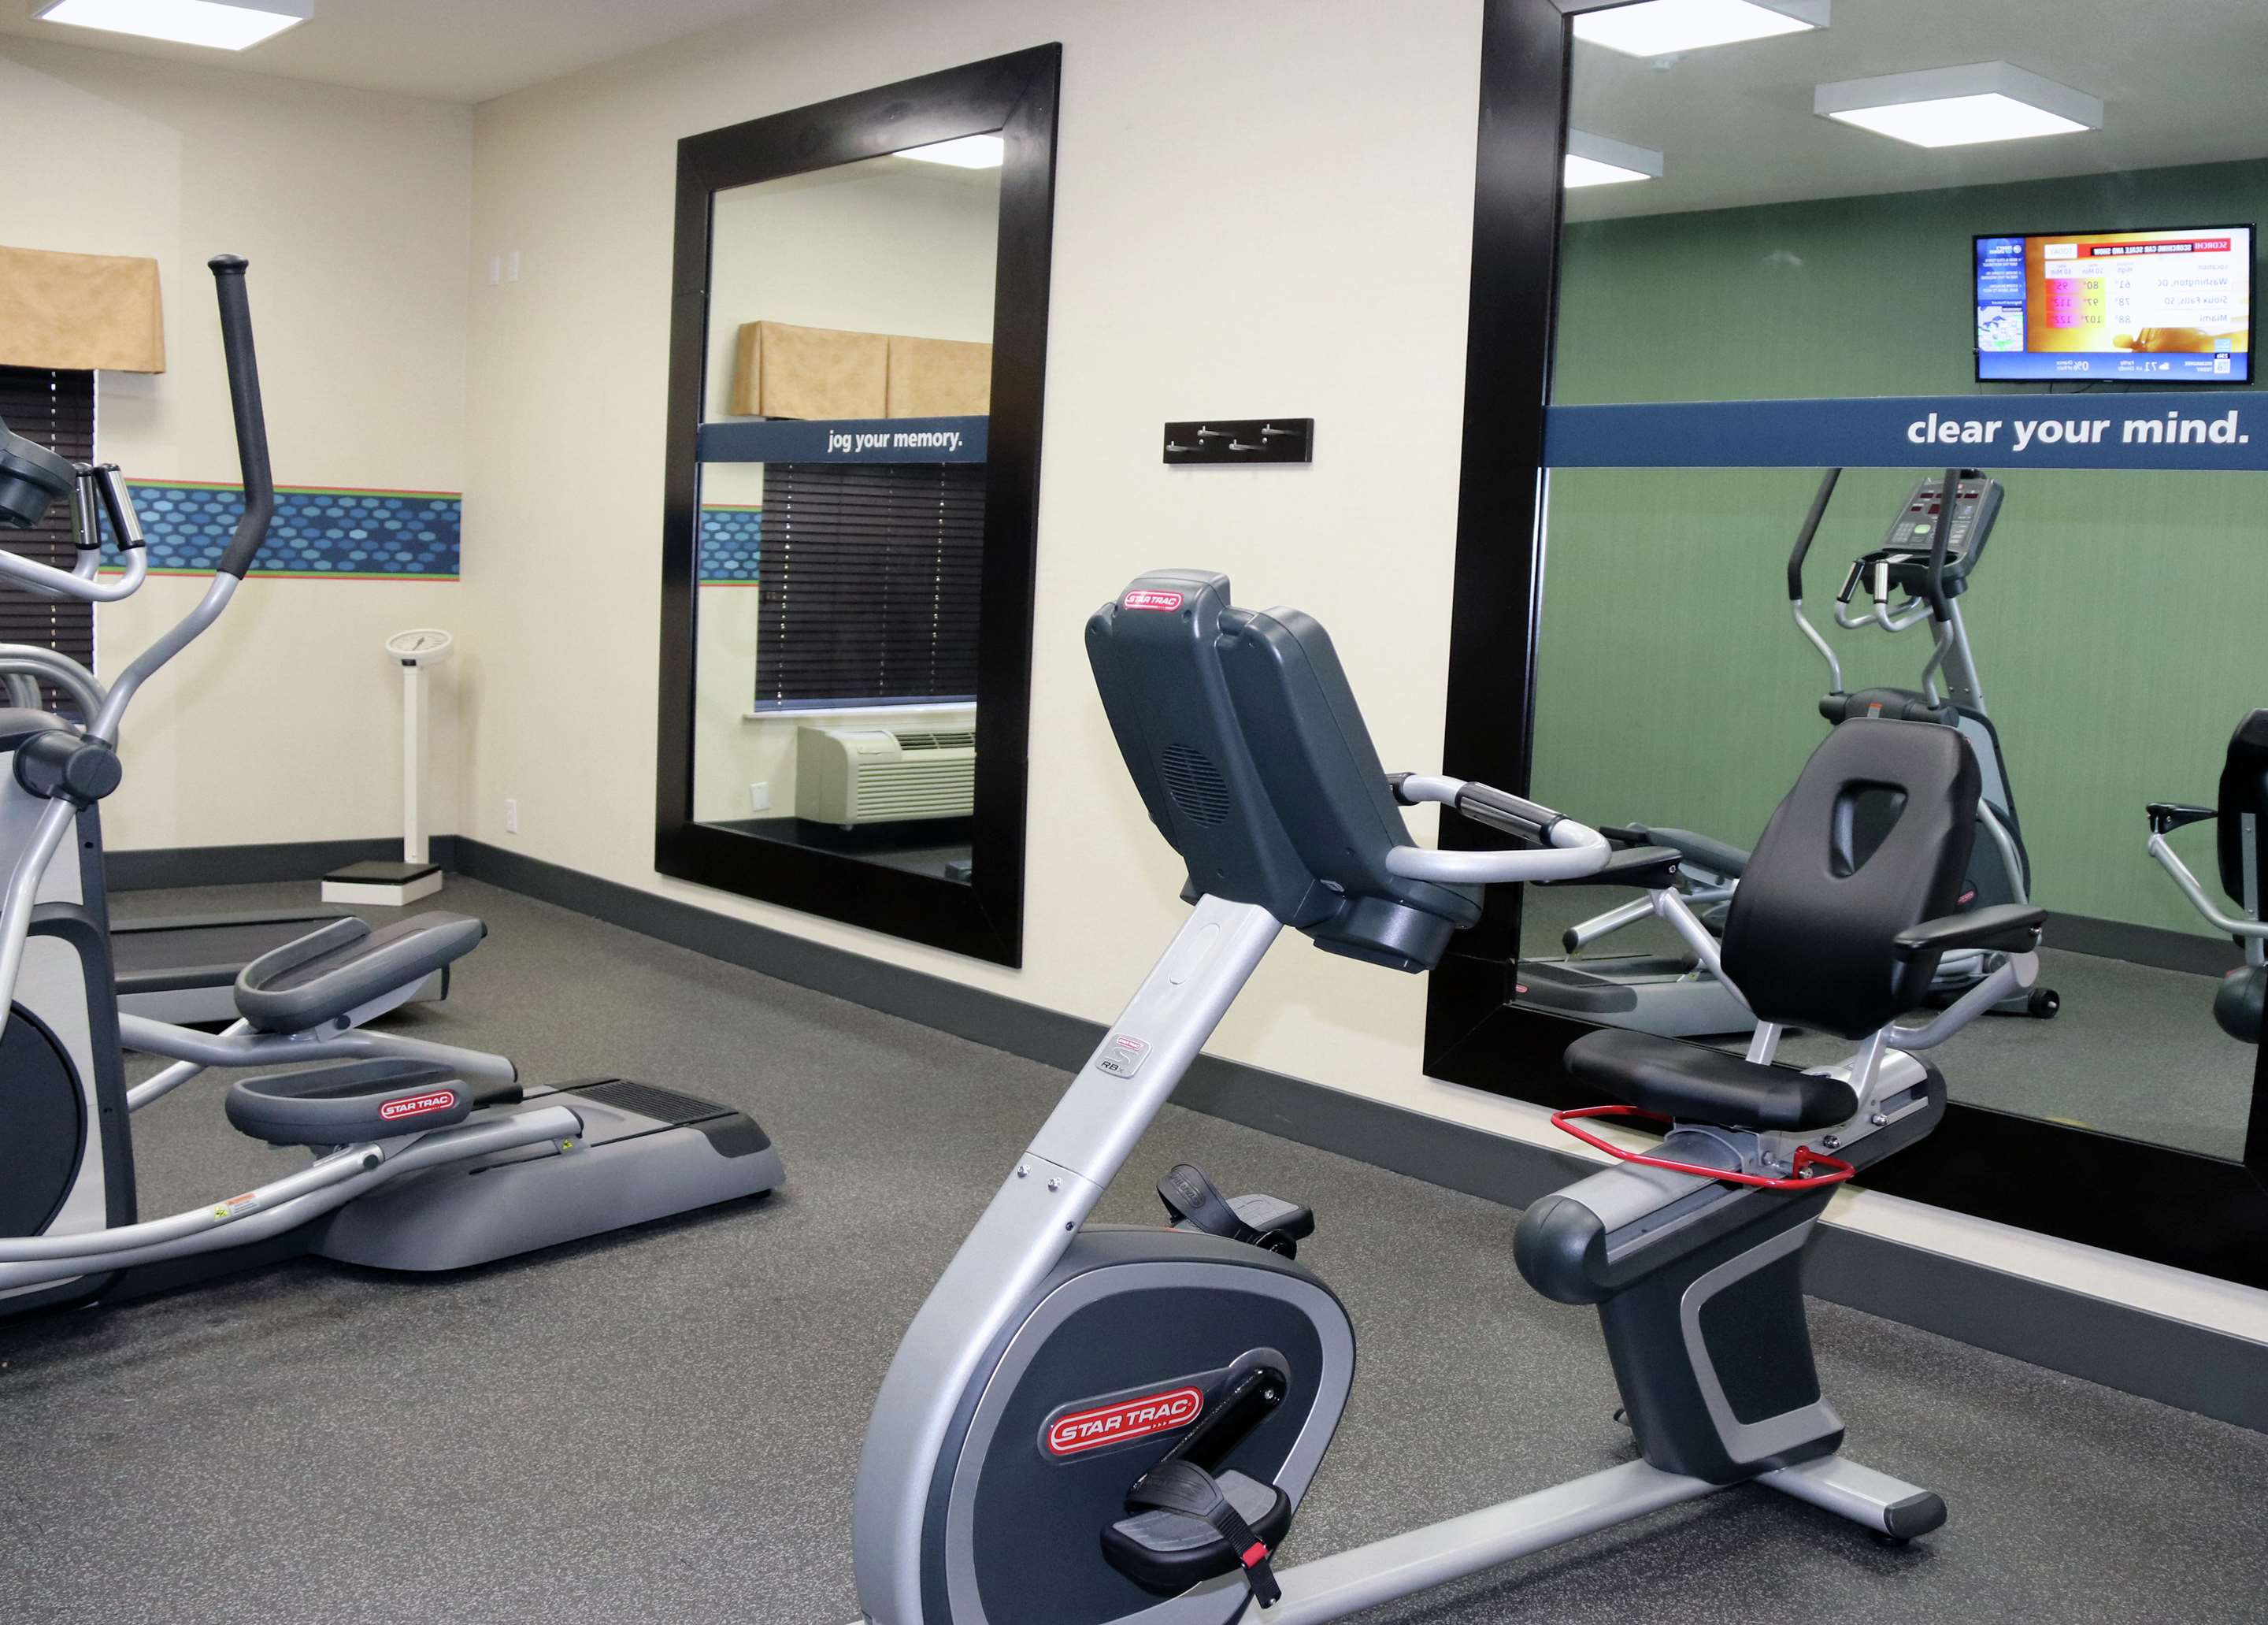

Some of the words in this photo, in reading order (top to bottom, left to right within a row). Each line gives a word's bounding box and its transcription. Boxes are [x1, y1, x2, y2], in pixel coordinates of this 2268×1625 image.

[827, 429, 852, 453] jog
[854, 433, 891, 453] your
[893, 432, 963, 452] memory.
[1907, 412, 2003, 443] clear
[2012, 419, 2111, 452] your
[2122, 410, 2250, 444] mind.
[1126, 595, 1149, 605] STAR
[1149, 596, 1177, 606] TRAC
[384, 1103, 417, 1115] STAR
[417, 1096, 448, 1108] TRAC
[1058, 1415, 1123, 1441] STAR
[1126, 1399, 1188, 1426] TRAC
